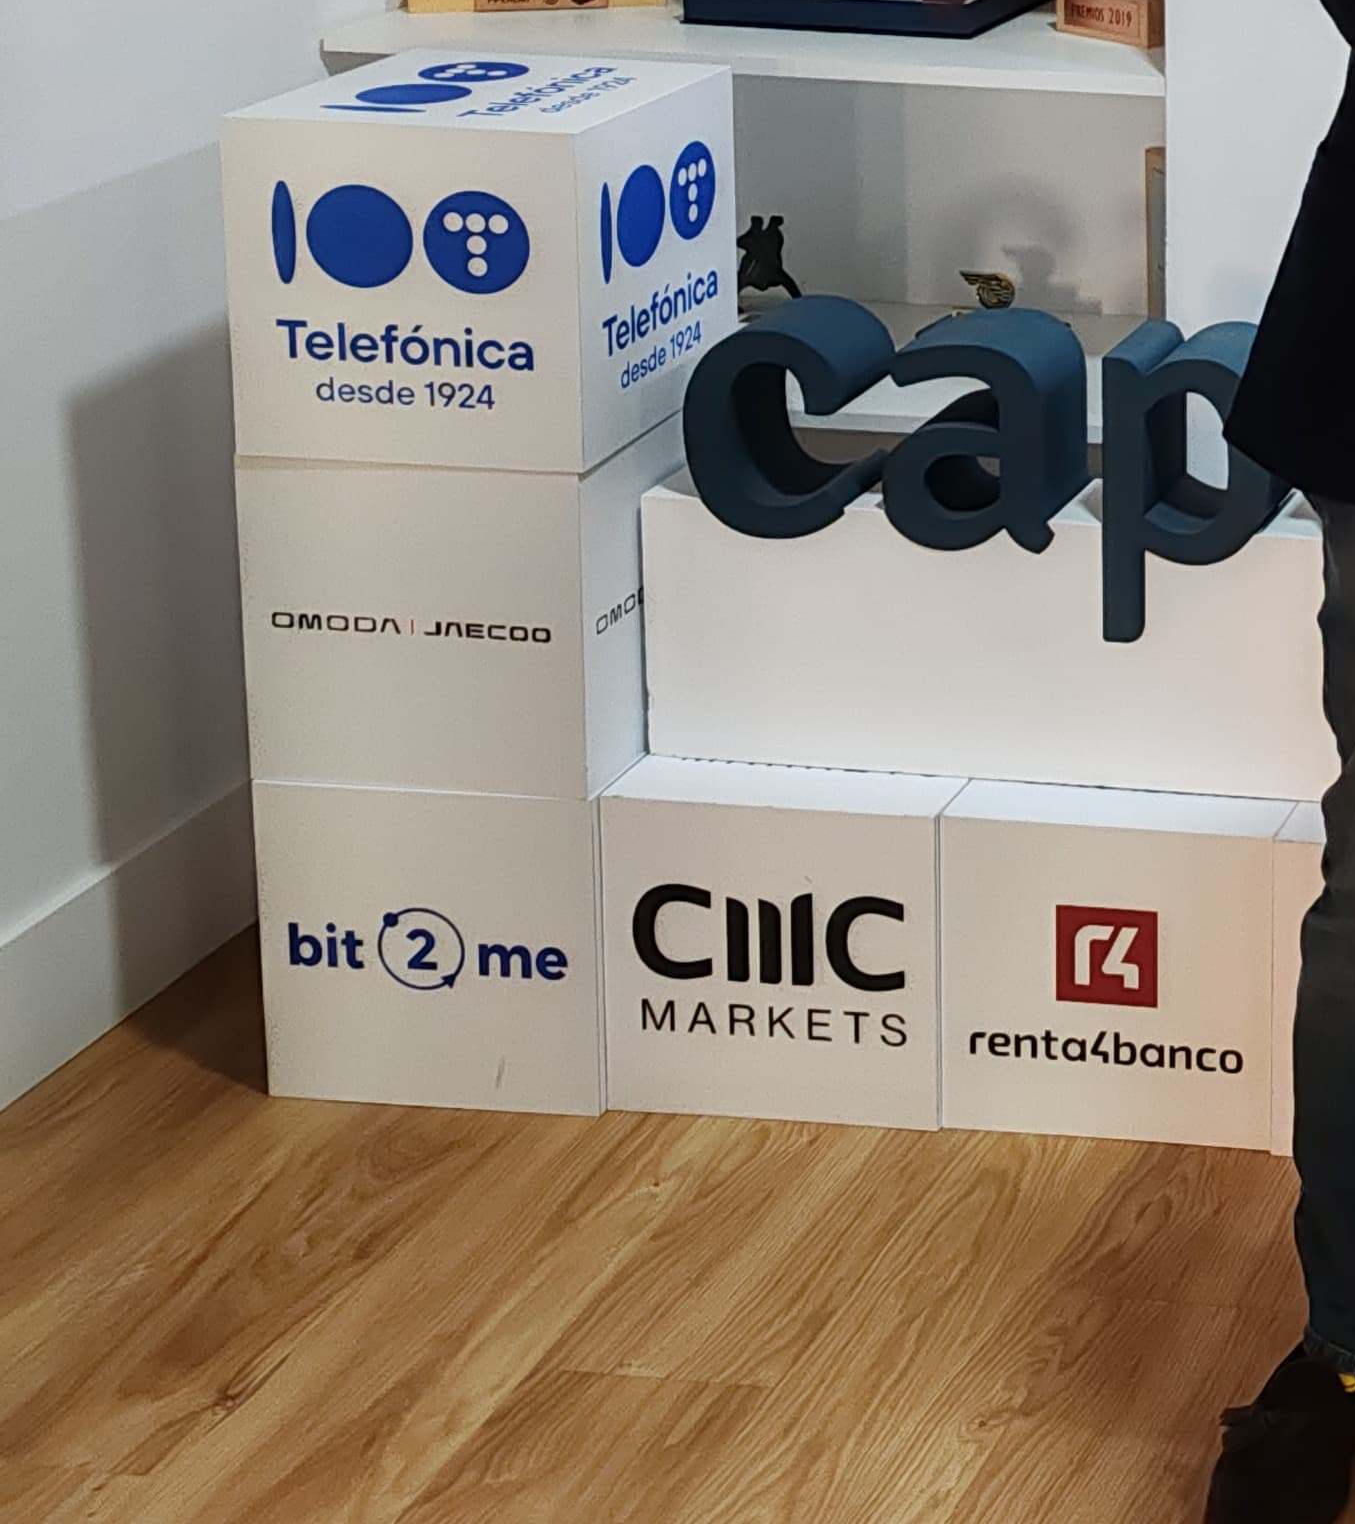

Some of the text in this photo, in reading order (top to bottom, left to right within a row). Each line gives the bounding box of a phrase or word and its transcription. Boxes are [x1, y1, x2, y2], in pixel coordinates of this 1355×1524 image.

[1108, 6, 1133, 27] 2019
[602, 269, 719, 357] Telefónica
[276, 319, 535, 372] Telefónica
[620, 321, 702, 389] desde 1924
[316, 376, 495, 410] desde 1924
[424, 621, 551, 643] JAECOO
[641, 998, 909, 1047] MARKETS
[969, 1030, 1244, 1075] renta4banco
